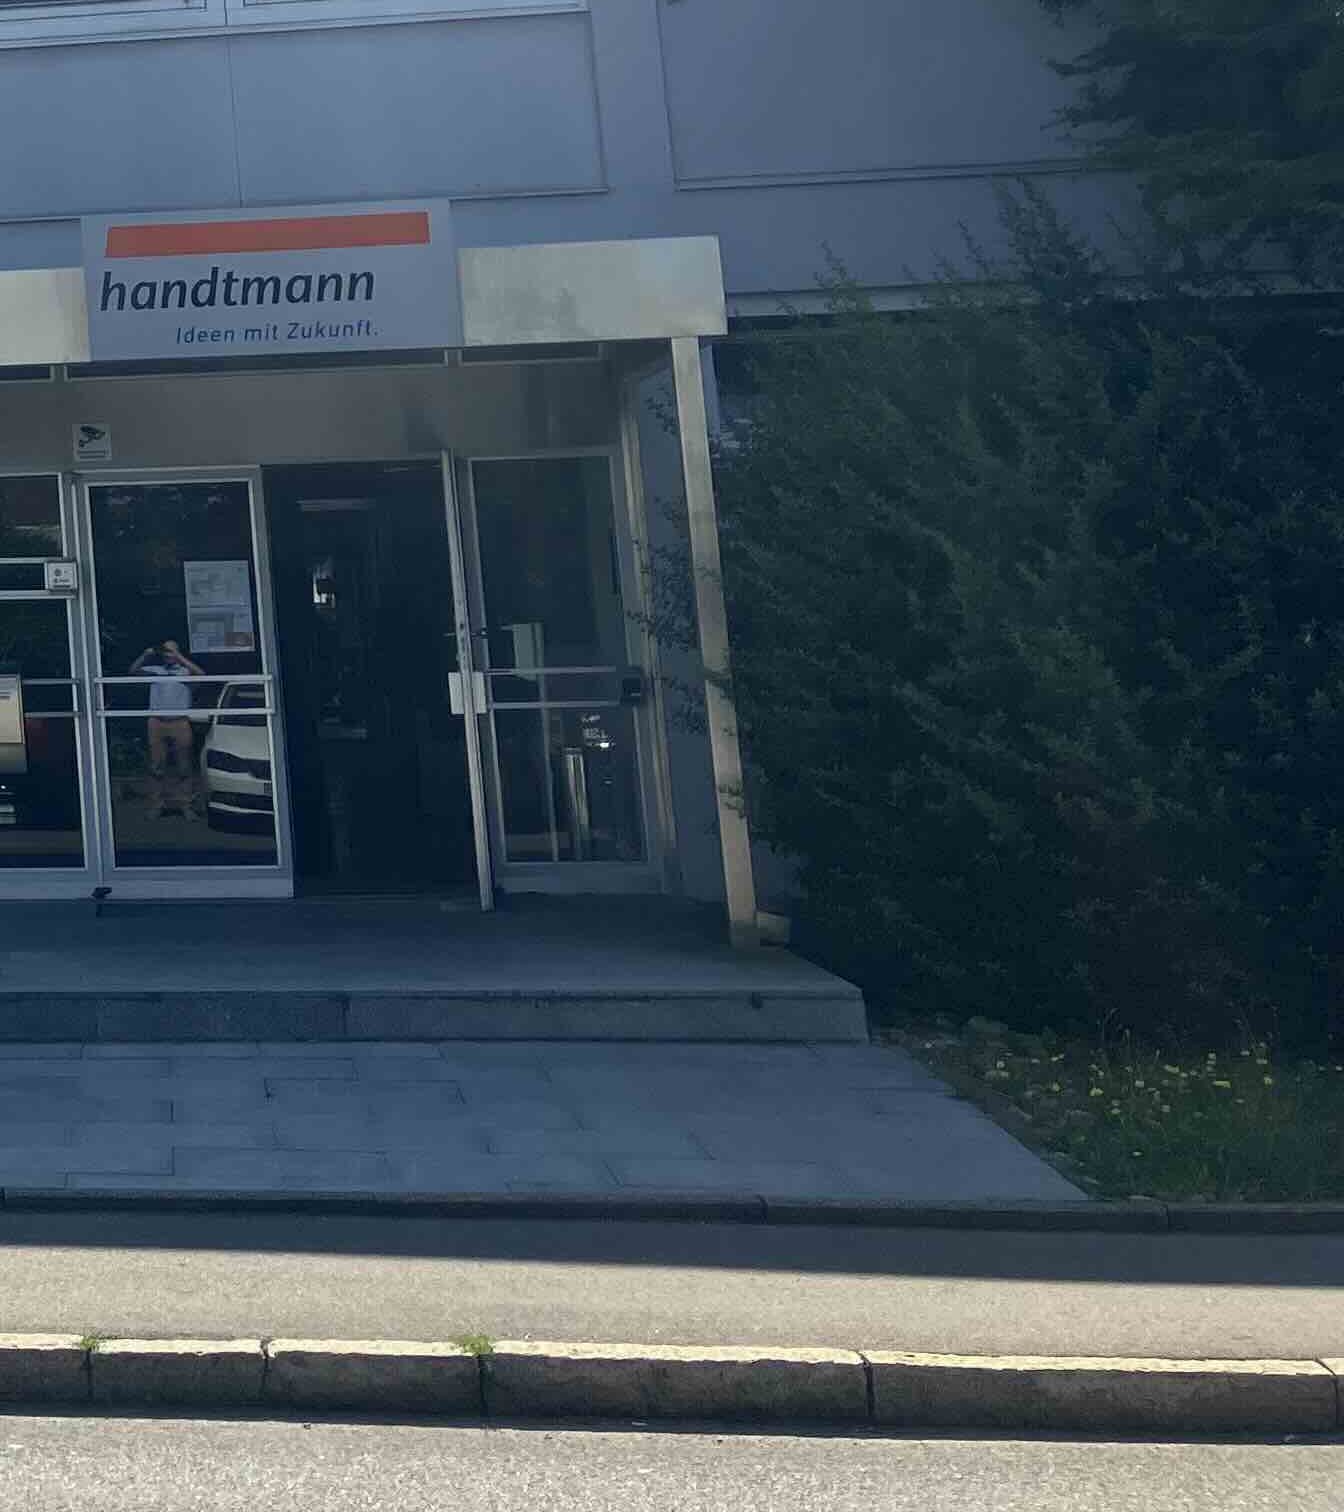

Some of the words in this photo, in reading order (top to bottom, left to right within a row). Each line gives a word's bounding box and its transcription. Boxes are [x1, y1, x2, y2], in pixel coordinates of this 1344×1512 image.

[100, 266, 375, 311] handtmann
[176, 326, 235, 345] Ideen
[243, 323, 279, 342] mit
[287, 319, 379, 341] Zukunft.
